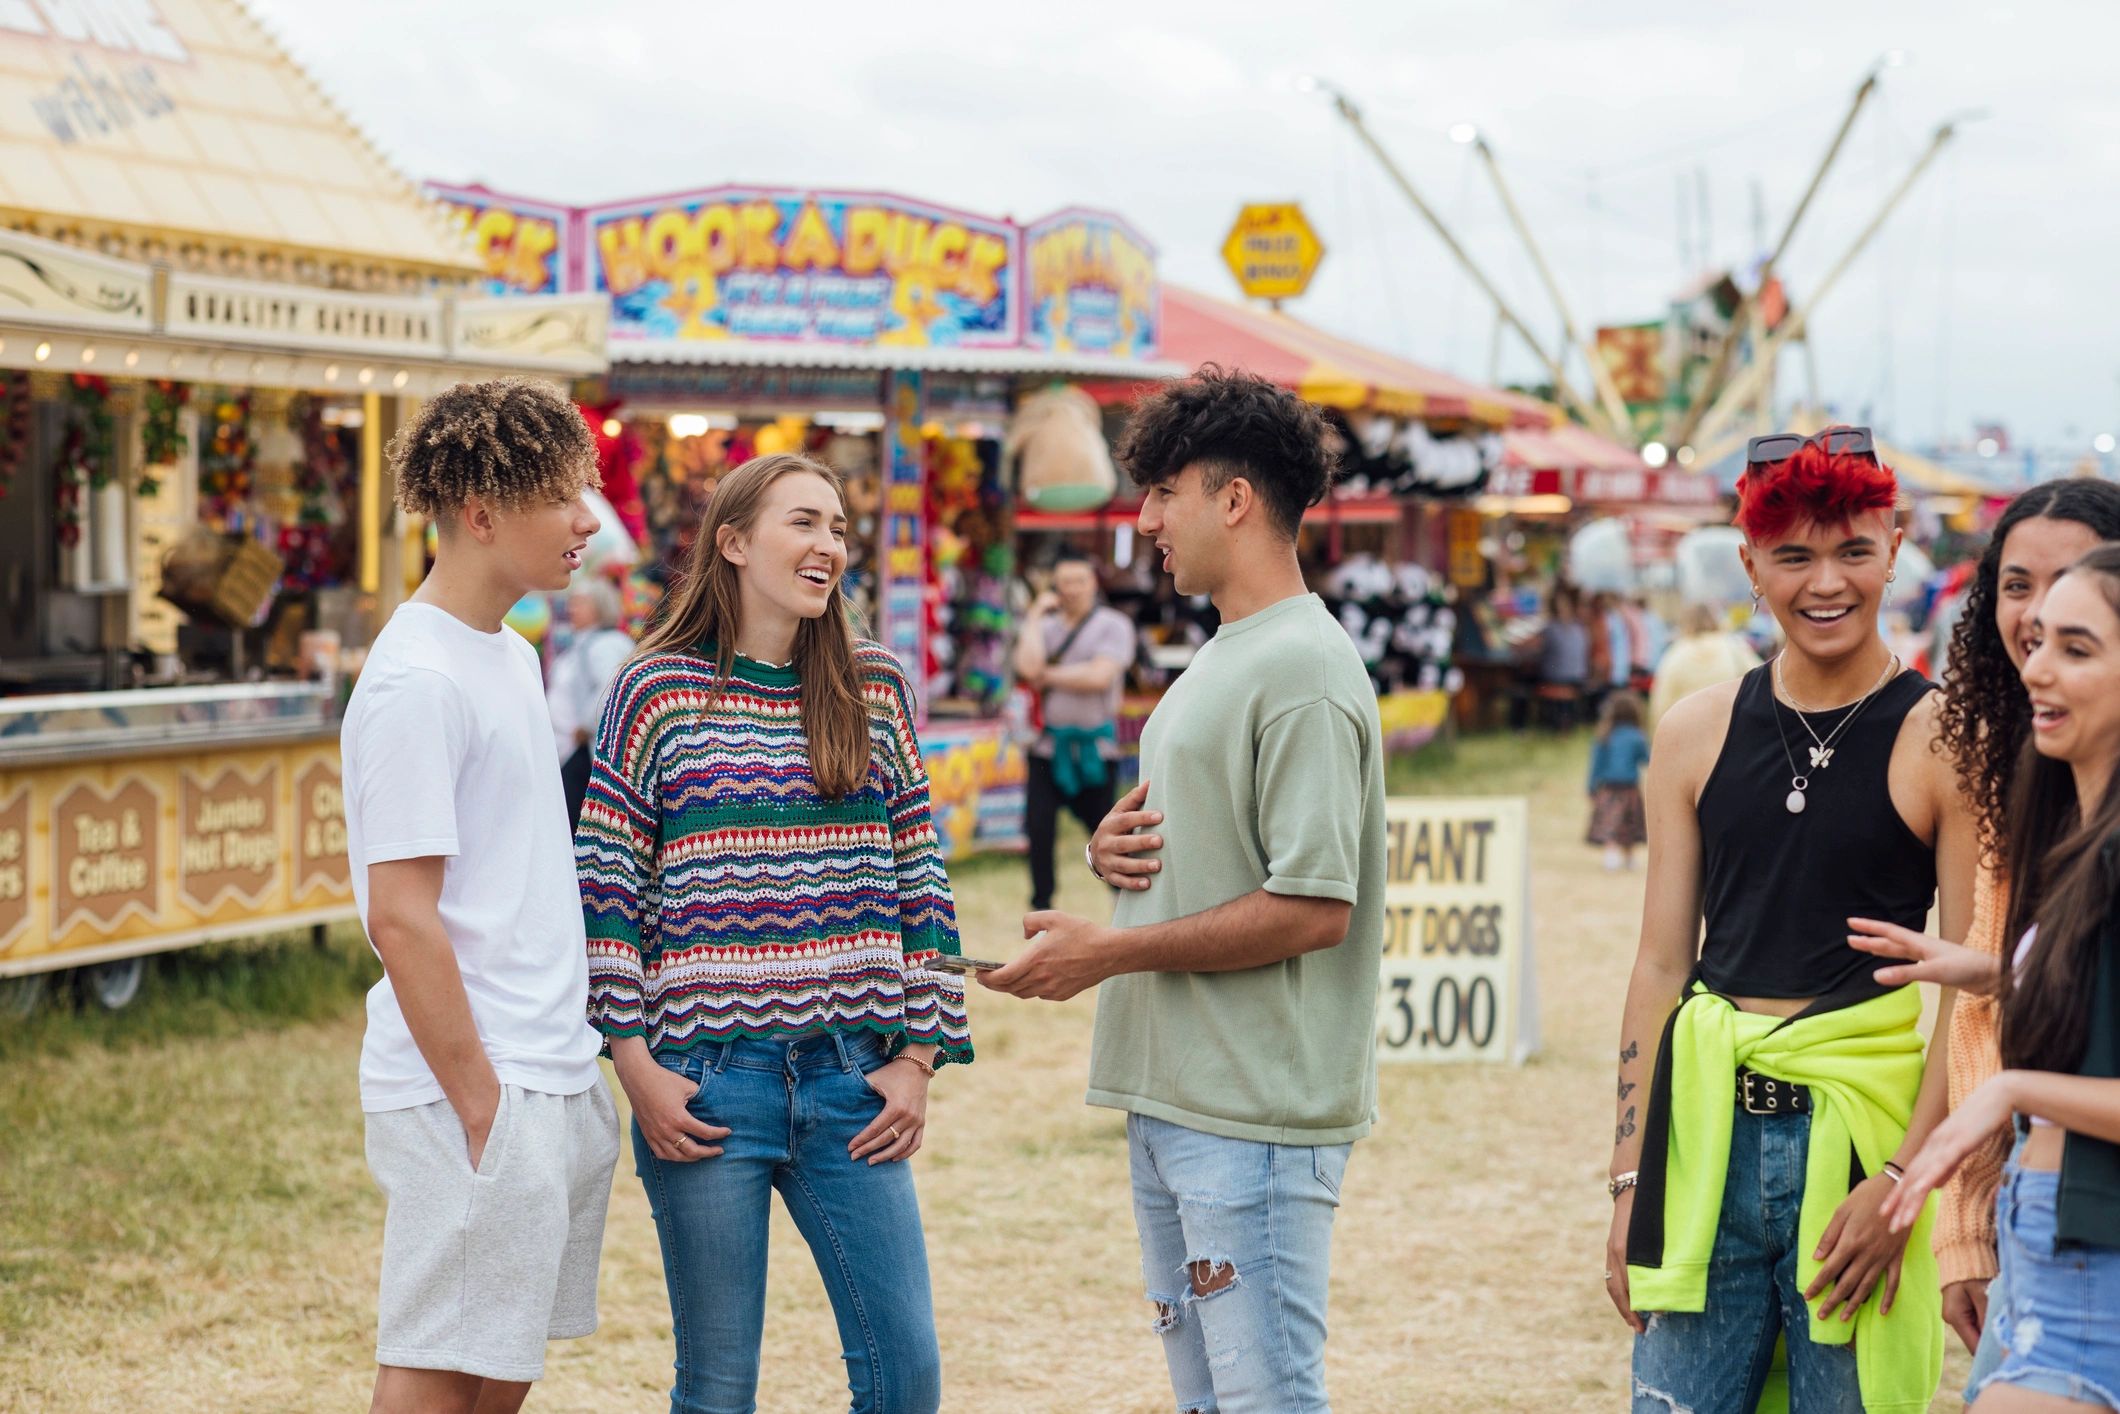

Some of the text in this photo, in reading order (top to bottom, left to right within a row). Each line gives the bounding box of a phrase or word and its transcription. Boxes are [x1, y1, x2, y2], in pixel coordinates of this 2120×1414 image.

[597, 198, 782, 294] HOOK
[782, 191, 841, 271] A
[844, 205, 1008, 305] DUCK
[186, 294, 298, 327] QUALITY
[316, 307, 429, 339] CATERING
[74, 807, 142, 855] Tea &
[195, 796, 266, 834] Jumbo
[69, 855, 148, 898] Coffee
[184, 832, 279, 877] Hot Dogs
[1422, 905, 1502, 957] DOGS
[1382, 976, 1496, 1048] 3.00
